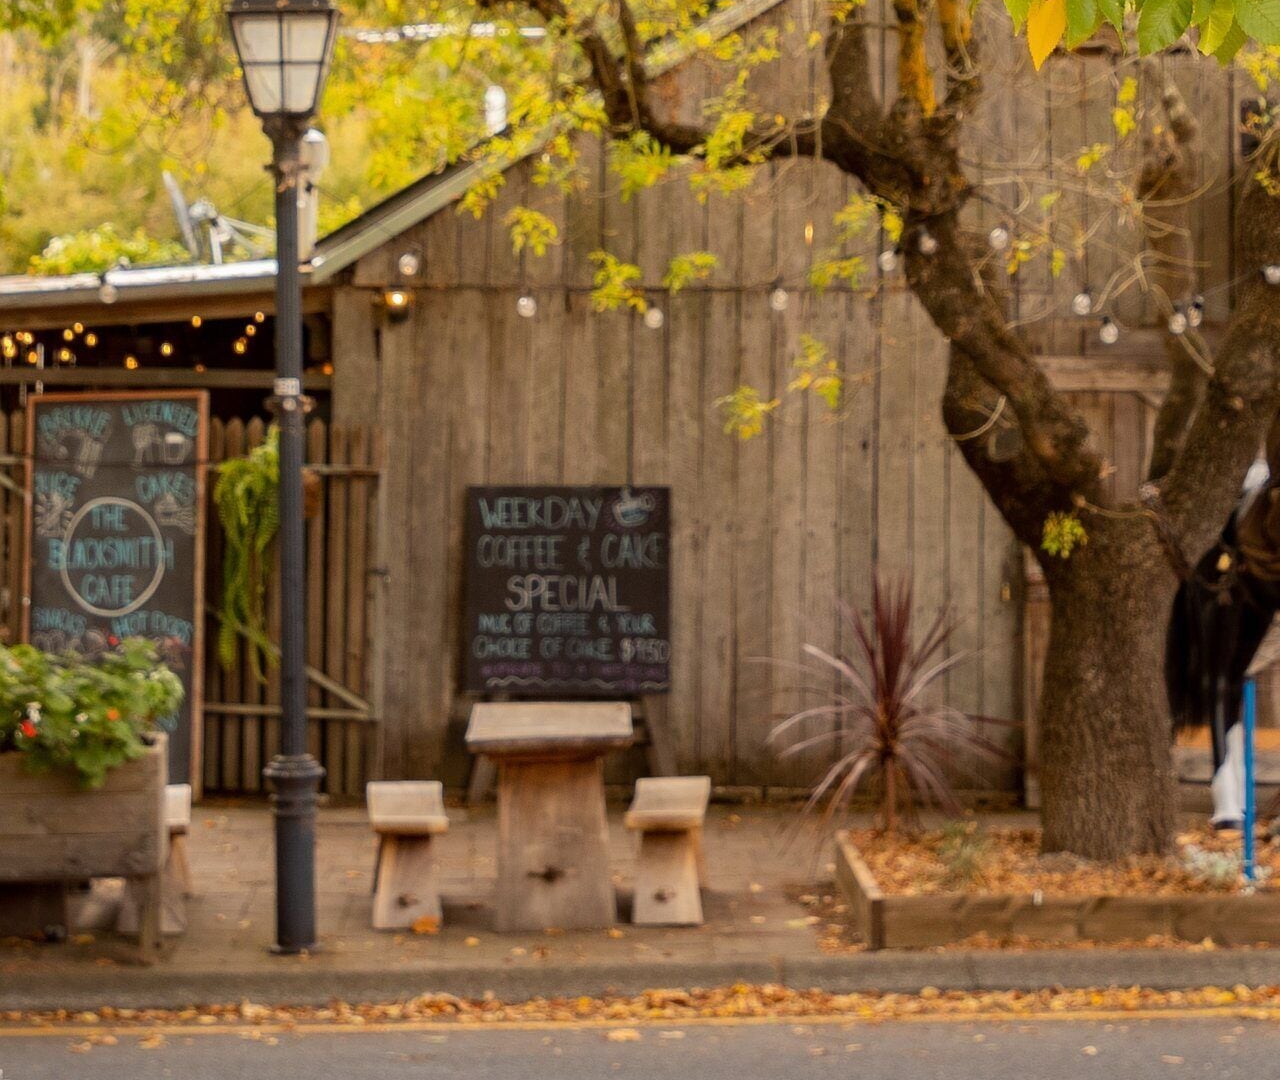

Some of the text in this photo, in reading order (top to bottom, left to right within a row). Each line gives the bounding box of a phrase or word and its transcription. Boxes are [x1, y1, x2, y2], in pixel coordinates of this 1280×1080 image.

[91, 504, 128, 531] THE
[478, 495, 603, 530] WEEKDAY
[48, 536, 174, 571] BLACKSMITH
[476, 532, 666, 570] COFFEE & CAKE
[81, 573, 136, 607] CAFE
[504, 573, 631, 611] SPECIAL
[478, 613, 512, 634] MUG
[513, 612, 534, 635] OF
[536, 612, 590, 635] COFFEE
[617, 612, 657, 635] YOUR
[472, 635, 532, 659] CHOICE
[539, 636, 564, 659] OF
[565, 637, 615, 661] CAKE
